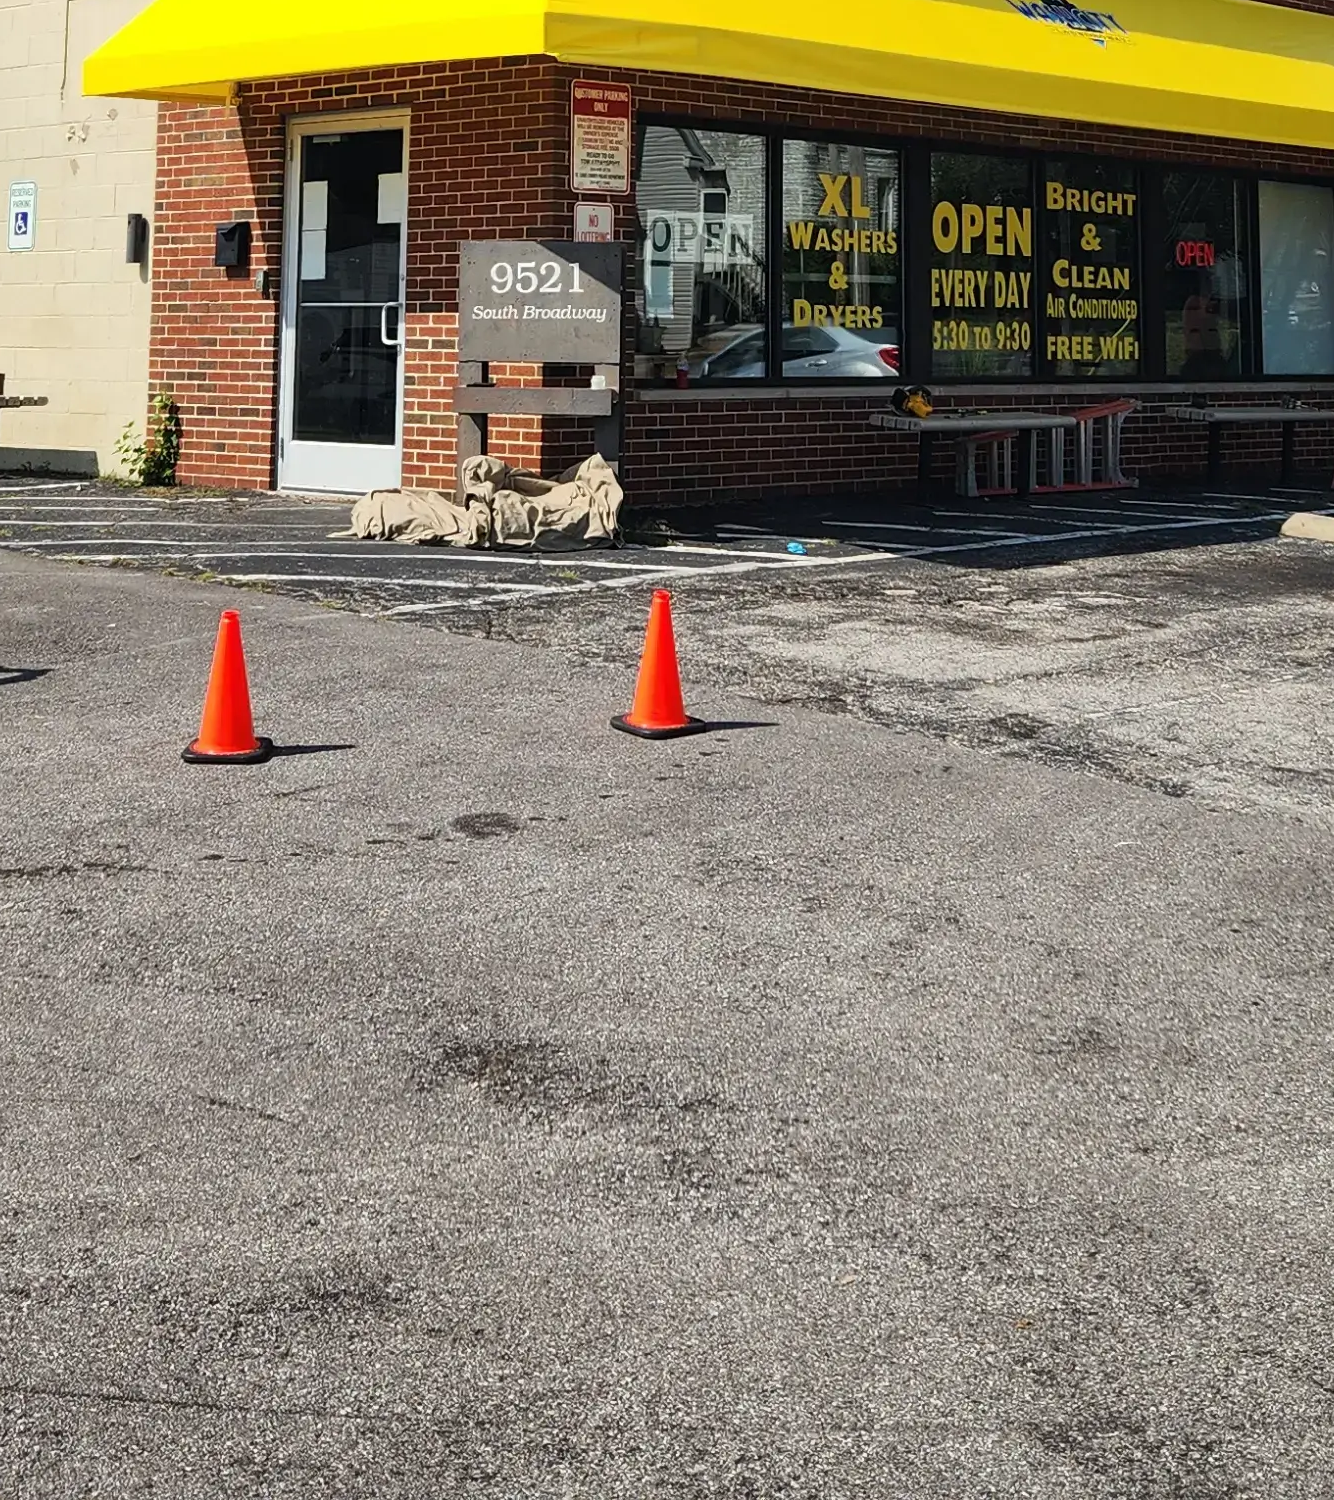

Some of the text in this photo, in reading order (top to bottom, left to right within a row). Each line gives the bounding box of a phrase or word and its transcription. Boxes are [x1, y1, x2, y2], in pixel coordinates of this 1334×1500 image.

[593, 102, 609, 112] ONLY
[604, 90, 628, 102] PARKING
[818, 173, 870, 219] XL
[1046, 181, 1137, 216] BRIGHT
[589, 214, 598, 228] NO
[932, 201, 1031, 257] OPEN
[651, 216, 752, 257] OPEN
[789, 221, 897, 254] WASHERS
[1080, 223, 1102, 252] &
[1176, 241, 1214, 266] OPEN
[490, 261, 584, 294] 9521
[828, 261, 848, 290] &
[931, 268, 1031, 308] EVERY DAY
[1052, 258, 1130, 290] CLEAN
[472, 304, 607, 323] South Broadway
[793, 298, 883, 328] DRYERS
[1046, 292, 1137, 320] AIR CONDITIONED
[933, 320, 1031, 351] 5:30 TO 9:30
[1046, 335, 1093, 361] FREE
